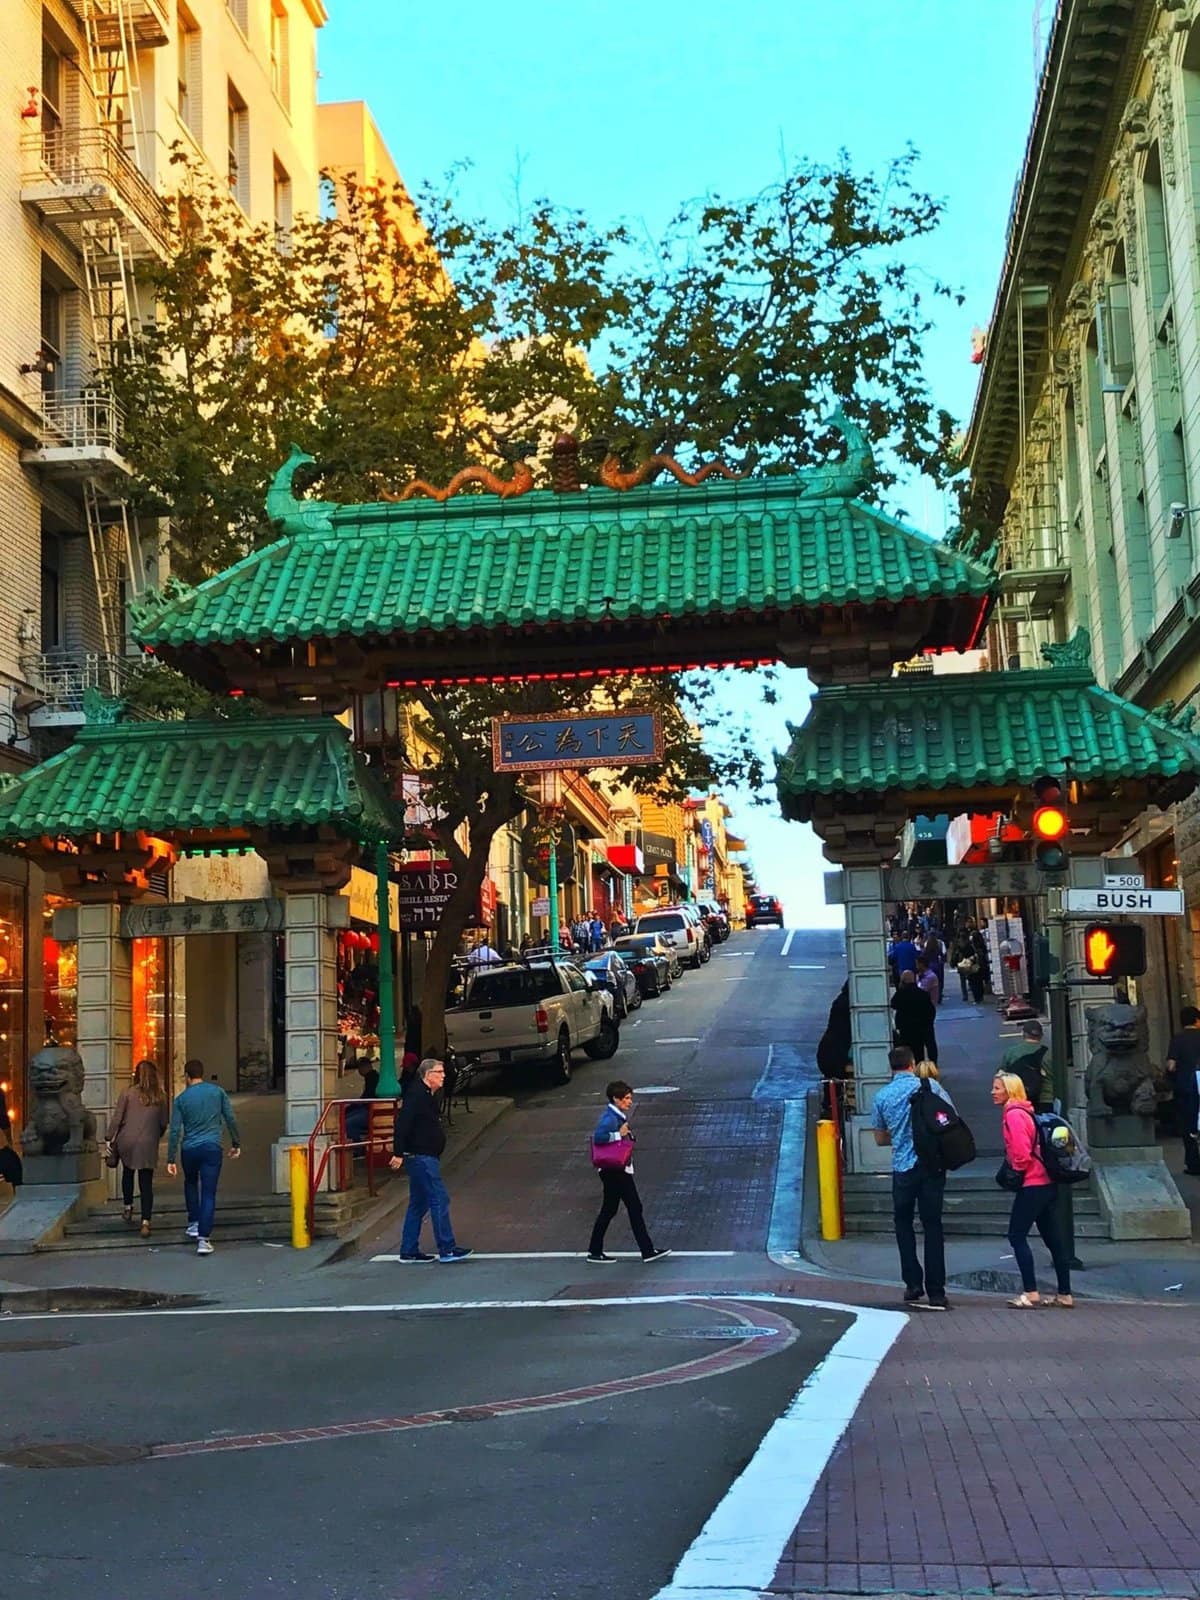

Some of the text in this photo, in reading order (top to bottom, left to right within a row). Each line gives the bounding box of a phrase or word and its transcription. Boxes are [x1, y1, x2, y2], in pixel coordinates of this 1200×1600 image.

[516, 722, 644, 753] 天下為公
[401, 873, 458, 890] SABR
[1119, 877, 1141, 887] 500
[424, 895, 451, 903] RESTA
[1097, 894, 1152, 908] BUSH
